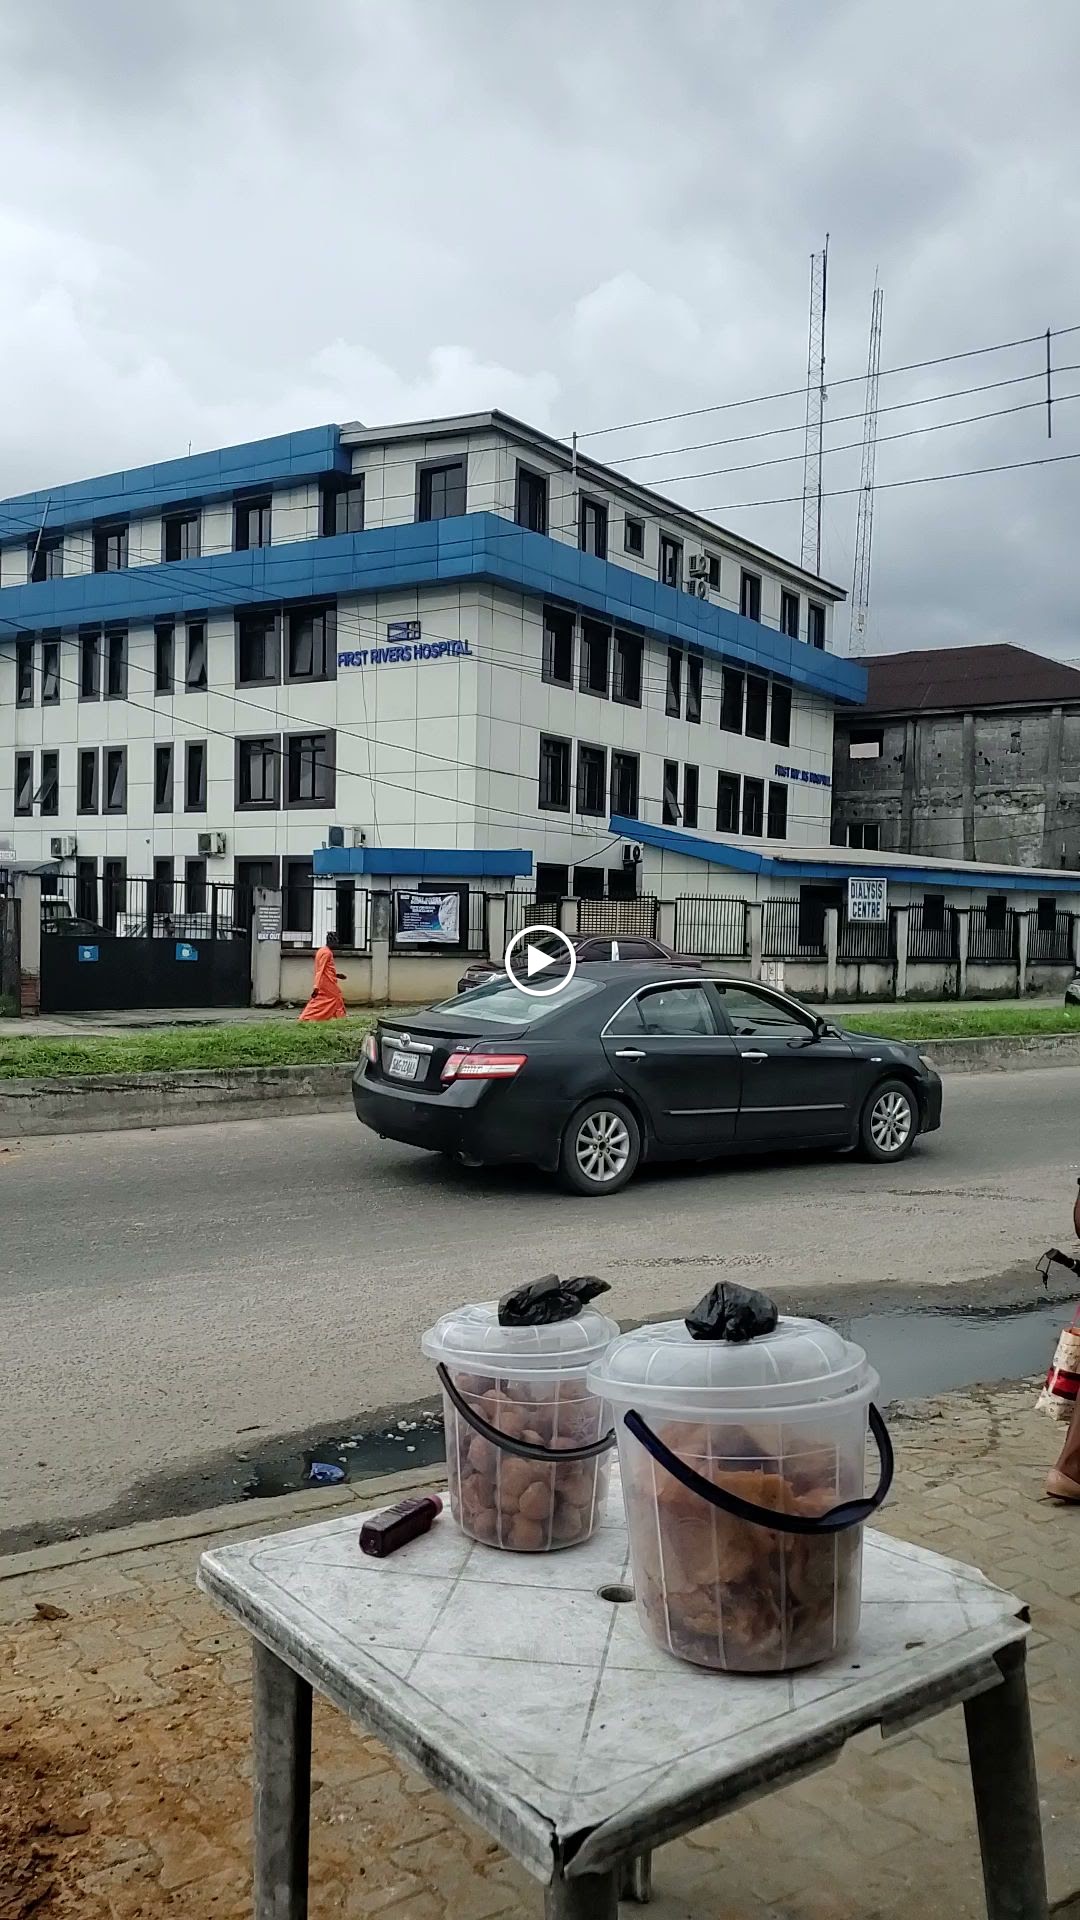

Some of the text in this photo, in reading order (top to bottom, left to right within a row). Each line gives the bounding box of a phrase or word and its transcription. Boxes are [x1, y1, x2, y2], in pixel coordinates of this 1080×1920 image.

[338, 639, 473, 667] FIRST RIVERS HOSPITAL
[850, 882, 883, 899] DIALYSIS
[852, 902, 880, 917] CENTRE
